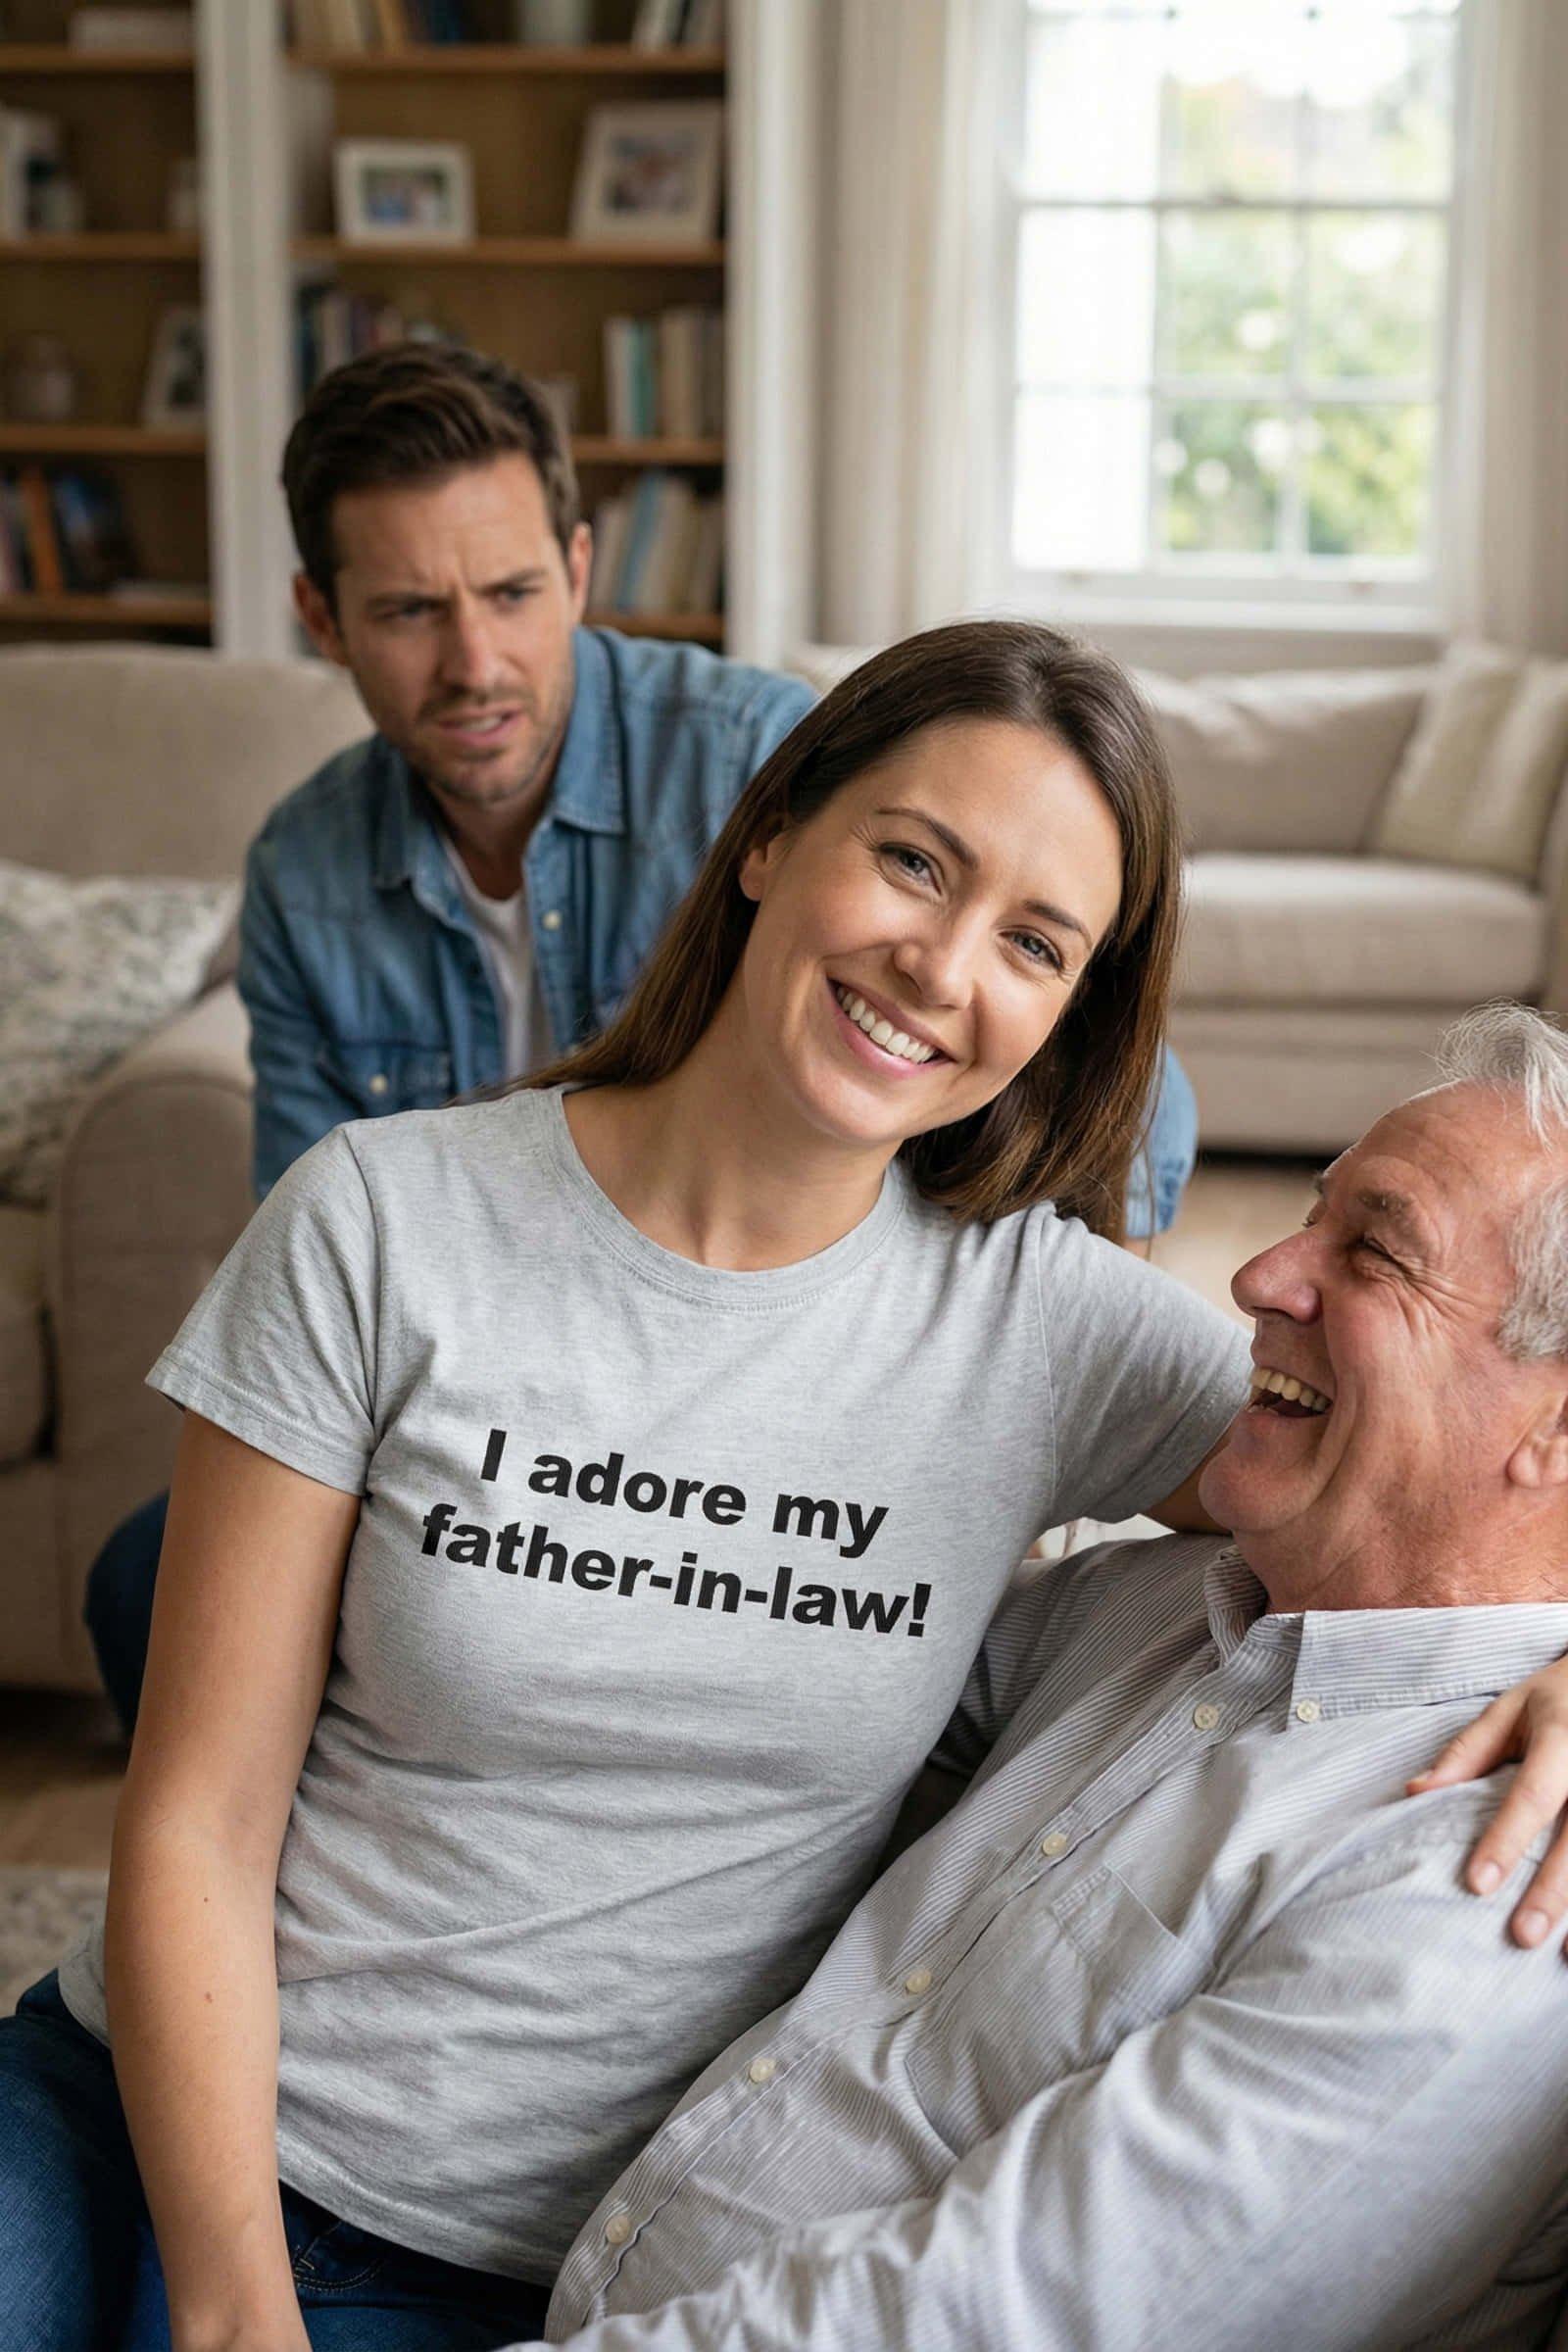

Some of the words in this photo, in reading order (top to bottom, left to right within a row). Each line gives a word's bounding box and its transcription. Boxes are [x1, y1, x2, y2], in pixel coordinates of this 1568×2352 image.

[480, 1429, 507, 1482] I
[528, 1451, 747, 1526] adore
[772, 1494, 890, 1559] my
[420, 1503, 932, 1638] father-in-law!
